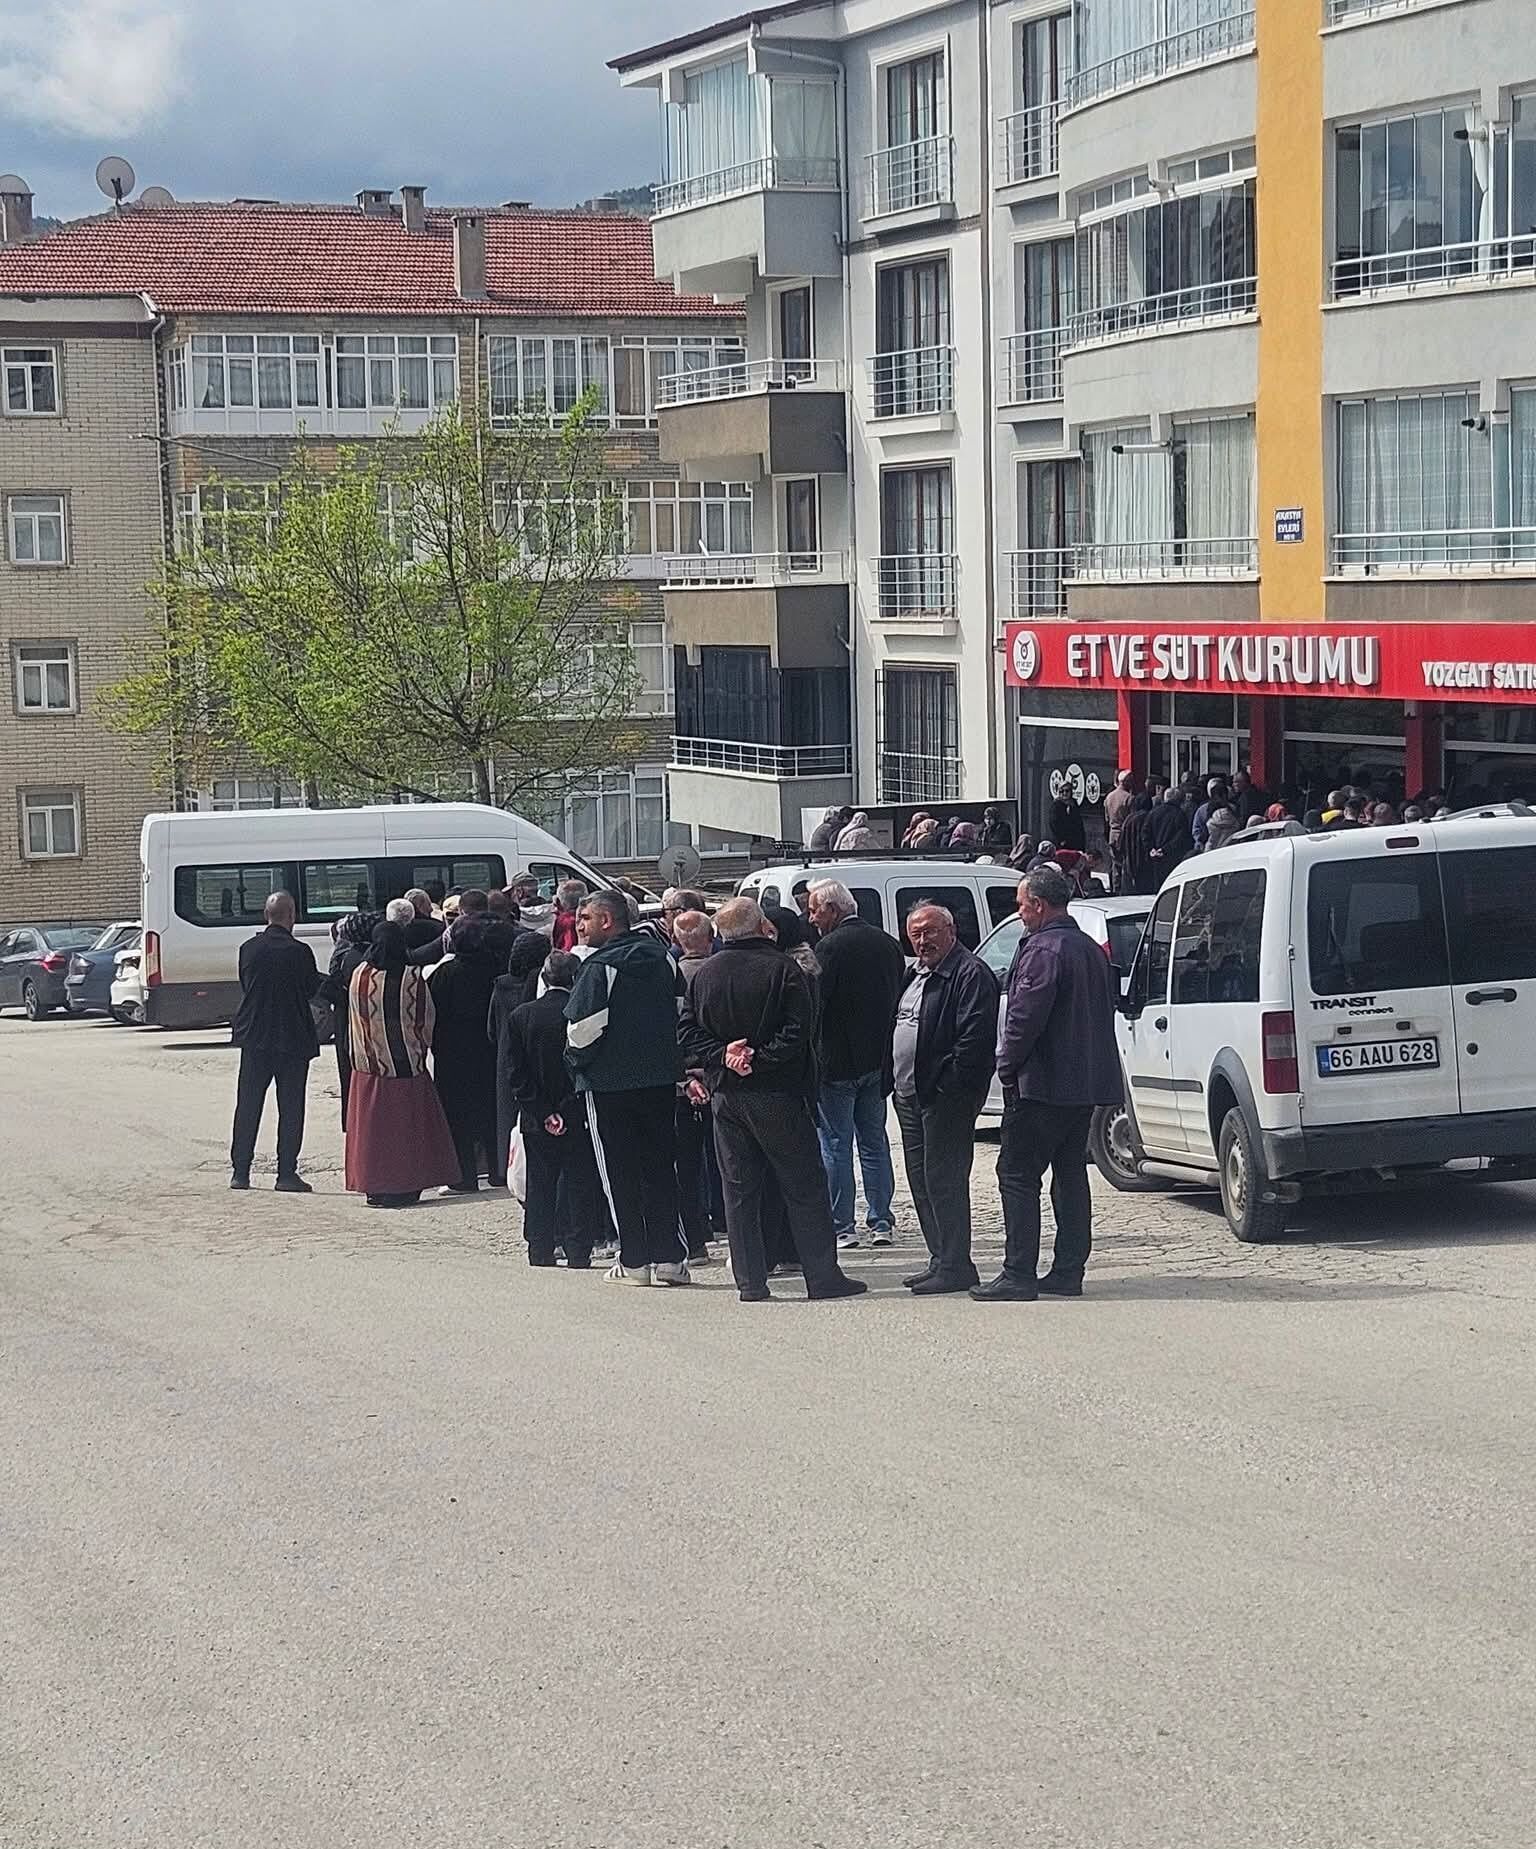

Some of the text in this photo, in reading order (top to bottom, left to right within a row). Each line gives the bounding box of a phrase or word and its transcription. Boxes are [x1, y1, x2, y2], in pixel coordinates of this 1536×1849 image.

[1067, 634, 1380, 686] ET VE SÜT KURUMU
[1421, 661, 1492, 688] YOZGAT
[1310, 996, 1376, 1010] TRANSIT
[1348, 1006, 1394, 1016] connect
[1330, 1049, 1353, 1068] 66
[1359, 1045, 1394, 1066] AAU
[1400, 1042, 1434, 1062] 628
